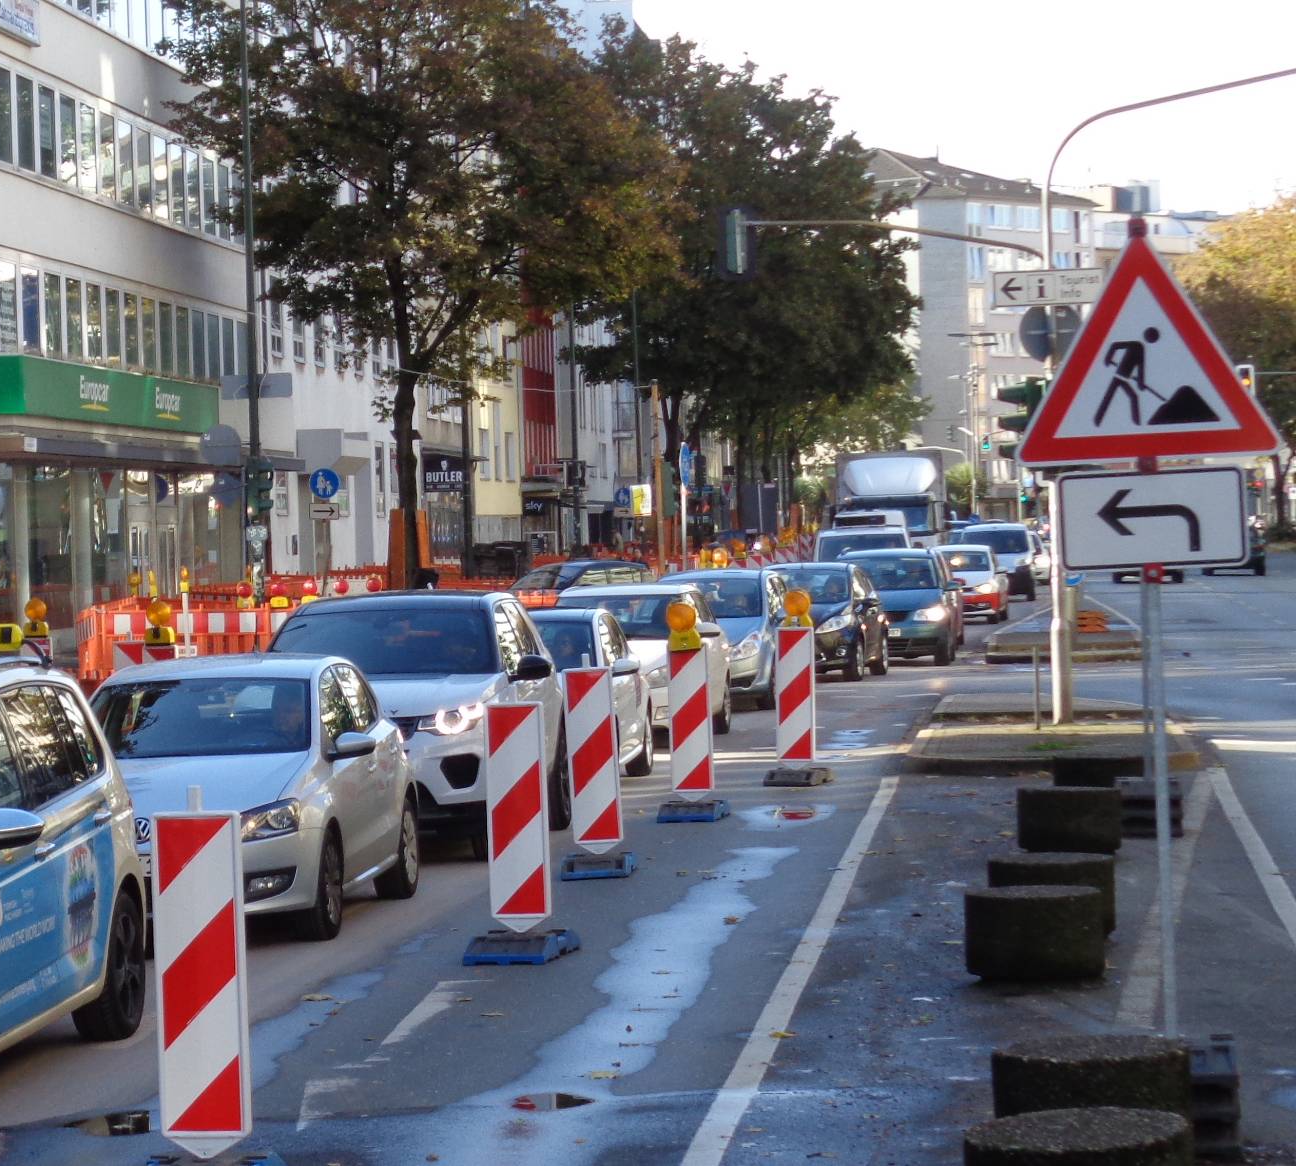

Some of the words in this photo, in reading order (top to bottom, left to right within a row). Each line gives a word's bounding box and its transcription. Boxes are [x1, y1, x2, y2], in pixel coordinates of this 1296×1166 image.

[79, 375, 109, 402] Europcar
[155, 386, 181, 412] Europcar
[426, 471, 463, 482] BUTLER
[525, 501, 543, 511] sky
